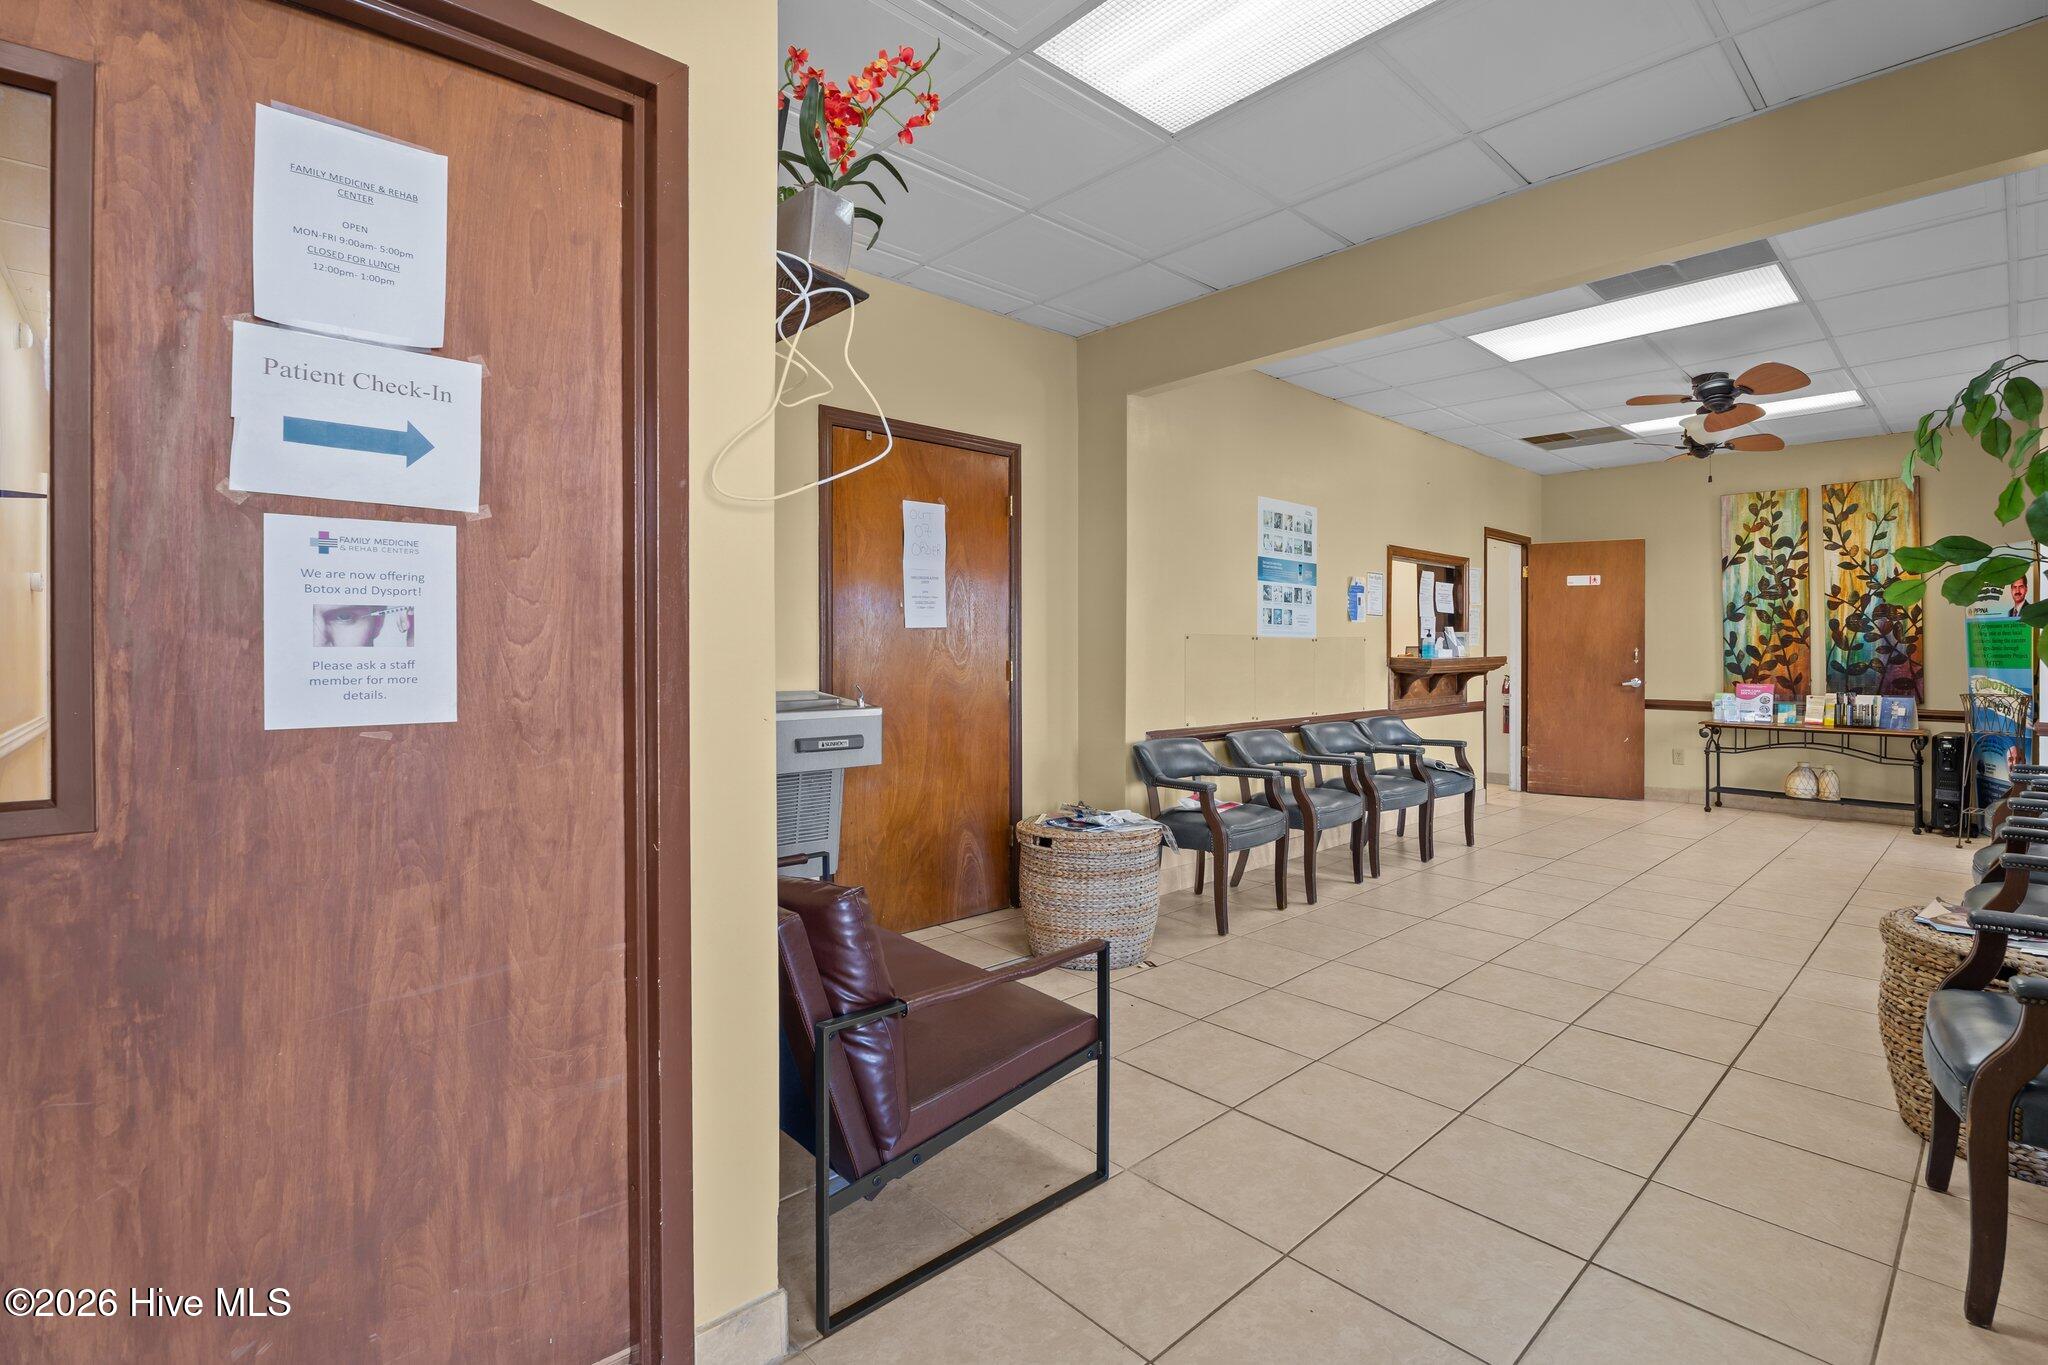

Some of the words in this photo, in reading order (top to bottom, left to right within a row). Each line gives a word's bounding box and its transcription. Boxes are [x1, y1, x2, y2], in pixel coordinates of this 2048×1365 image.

[290, 163, 327, 179] FAMILY
[329, 172, 376, 191] MEDICINE
[378, 184, 386, 194] &
[388, 187, 418, 202] REHAB
[337, 188, 374, 204] CENTER
[342, 220, 369, 234] OPEN
[292, 225, 337, 244] MON-FRI
[380, 244, 414, 260] 5:00pm
[307, 244, 345, 261] CLOSED
[347, 253, 366, 265] FOR
[368, 258, 400, 272] LUNCH
[361, 272, 395, 287] 1:00pm
[263, 356, 346, 387] Patient
[353, 372, 453, 404] Check-In
[339, 536, 371, 546] FAMILY
[374, 537, 419, 548] MEDICINE
[339, 544, 347, 552] &
[348, 544, 379, 553] REHAB
[381, 546, 420, 555] CENTERS
[300, 567, 322, 579] We
[325, 569, 346, 580] are
[350, 570, 376, 581] now
[379, 571, 425, 584] offering
[304, 584, 341, 595] Botox
[344, 584, 367, 596] and
[371, 585, 422, 598] Dysport!
[312, 660, 353, 671] Please
[356, 660, 376, 671] ask
[380, 662, 387, 671] a
[390, 659, 416, 671] staff
[309, 675, 363, 687] member
[367, 675, 384, 686] for
[387, 676, 418, 685] more
[343, 690, 387, 701] details.
